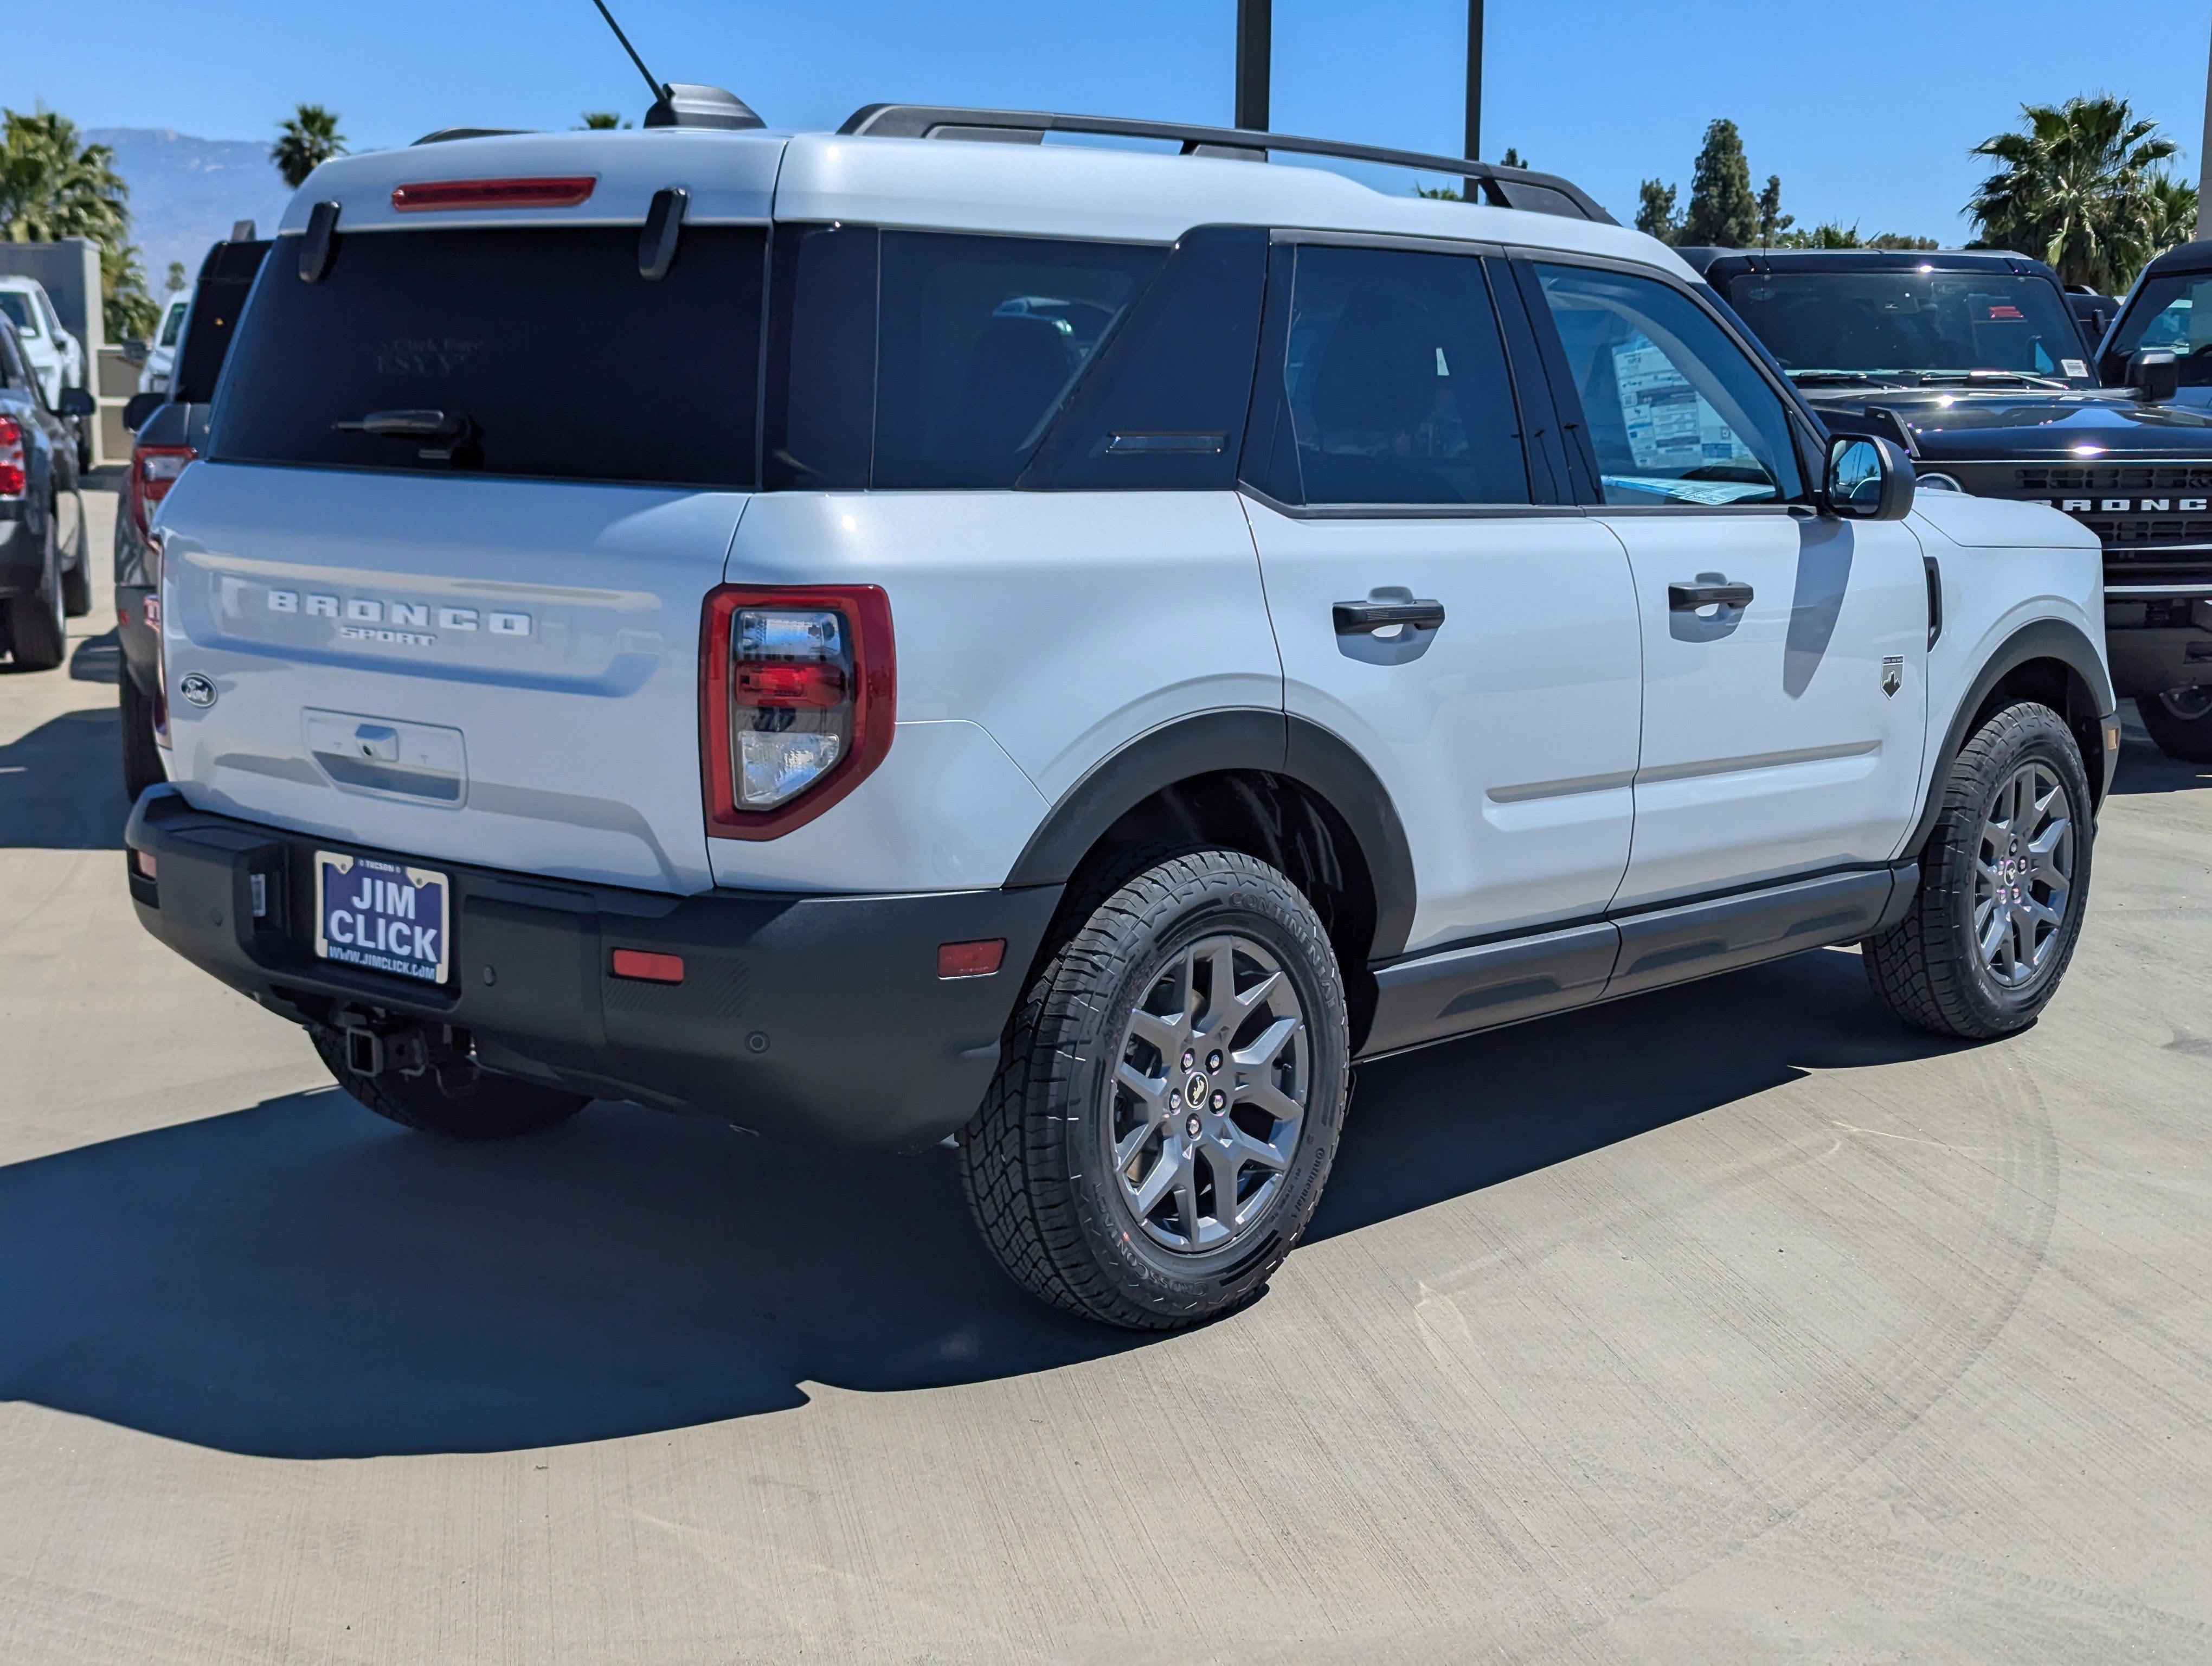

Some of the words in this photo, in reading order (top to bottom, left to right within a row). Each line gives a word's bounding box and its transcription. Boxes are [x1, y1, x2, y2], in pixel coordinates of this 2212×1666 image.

[268, 590, 532, 636] BRONCO
[340, 626, 437, 646] SPORT
[185, 678, 210, 703] Ford
[365, 860, 395, 873] TUCSON
[352, 877, 416, 920] JIM
[330, 909, 438, 963] CLICK
[329, 946, 435, 979] WWW.JIMCLICK.COM
